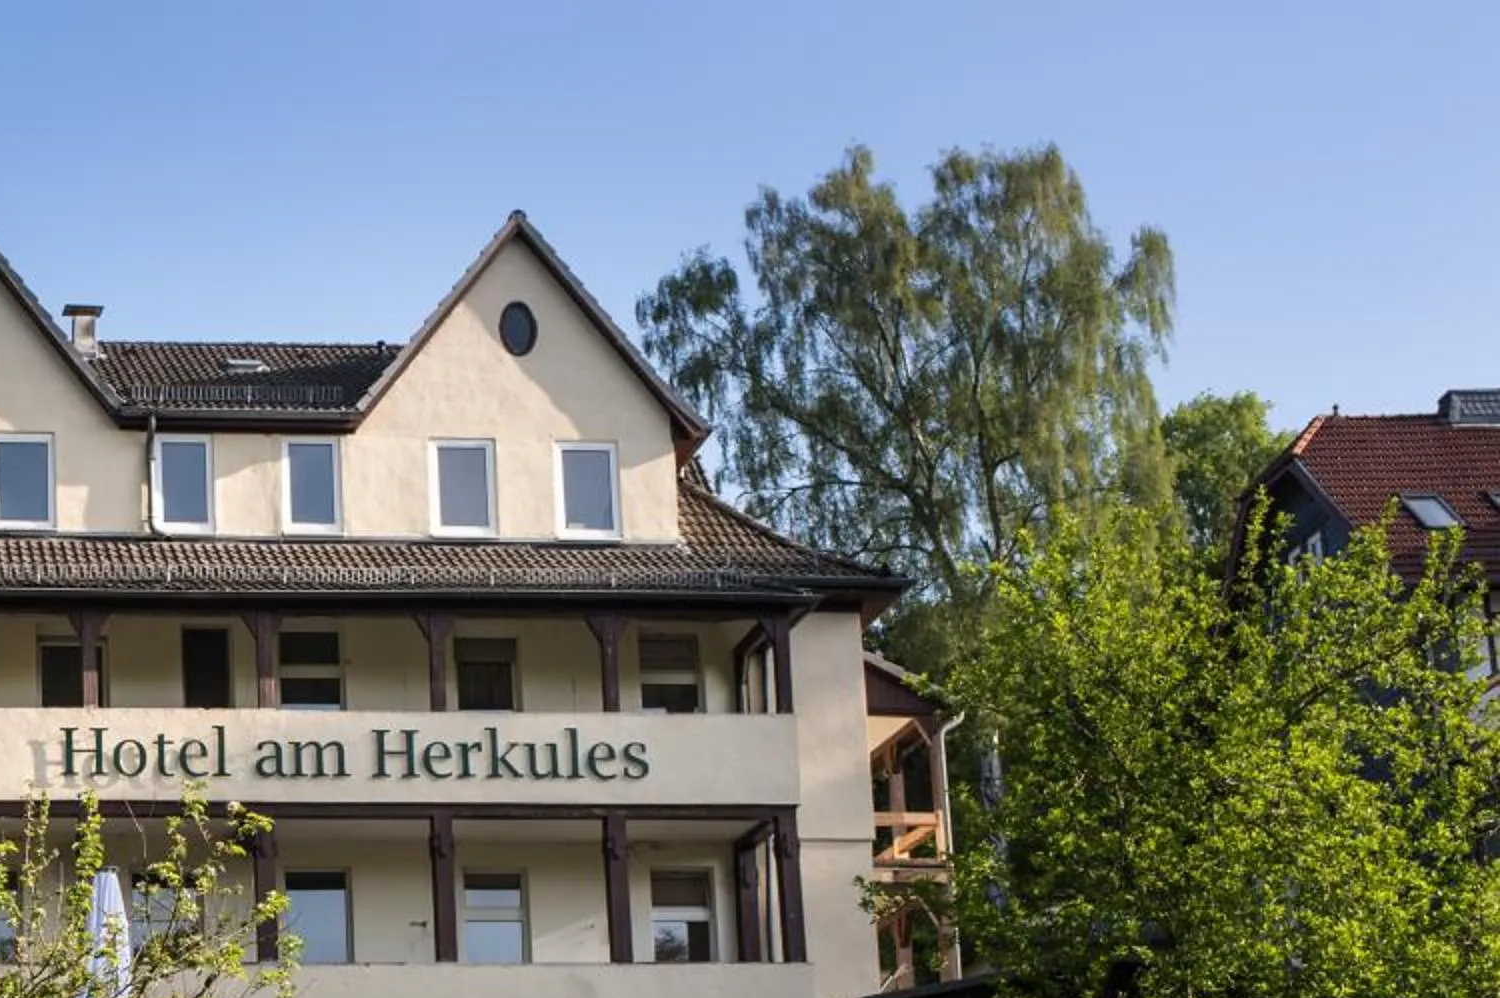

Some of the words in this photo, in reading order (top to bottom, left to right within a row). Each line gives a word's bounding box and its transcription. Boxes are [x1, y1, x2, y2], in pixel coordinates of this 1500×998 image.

[59, 725, 231, 778] Hotel
[255, 738, 351, 778] am
[371, 727, 650, 780] Herkules
